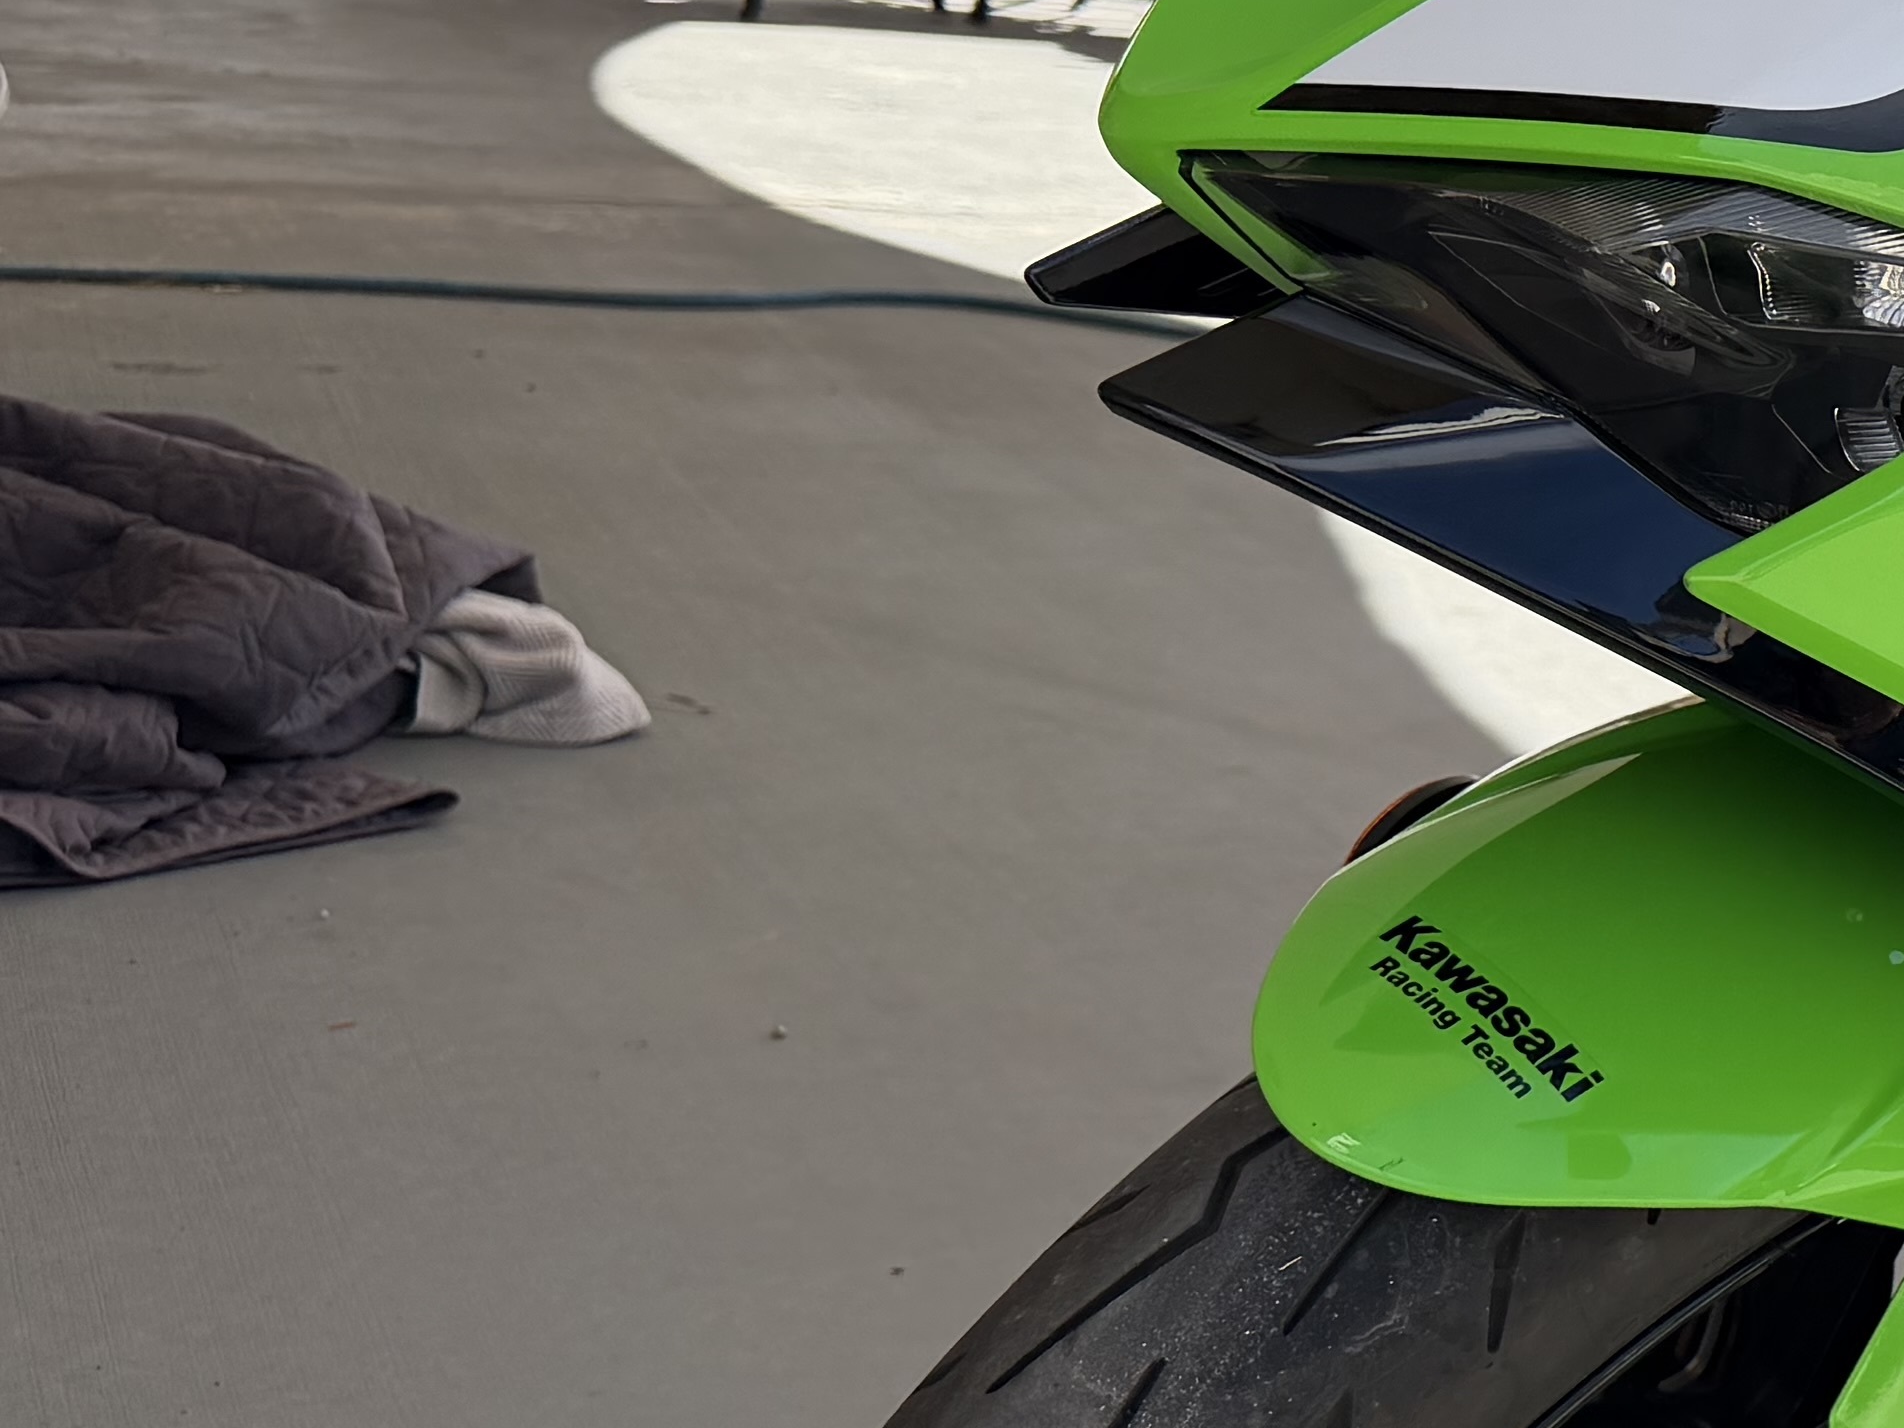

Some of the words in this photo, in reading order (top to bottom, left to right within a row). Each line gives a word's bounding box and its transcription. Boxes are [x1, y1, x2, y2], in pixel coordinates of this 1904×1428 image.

[1368, 956, 1462, 1030] Racing
[1460, 1023, 1533, 1099] Team
[1378, 915, 1605, 1103] Kawasaki
